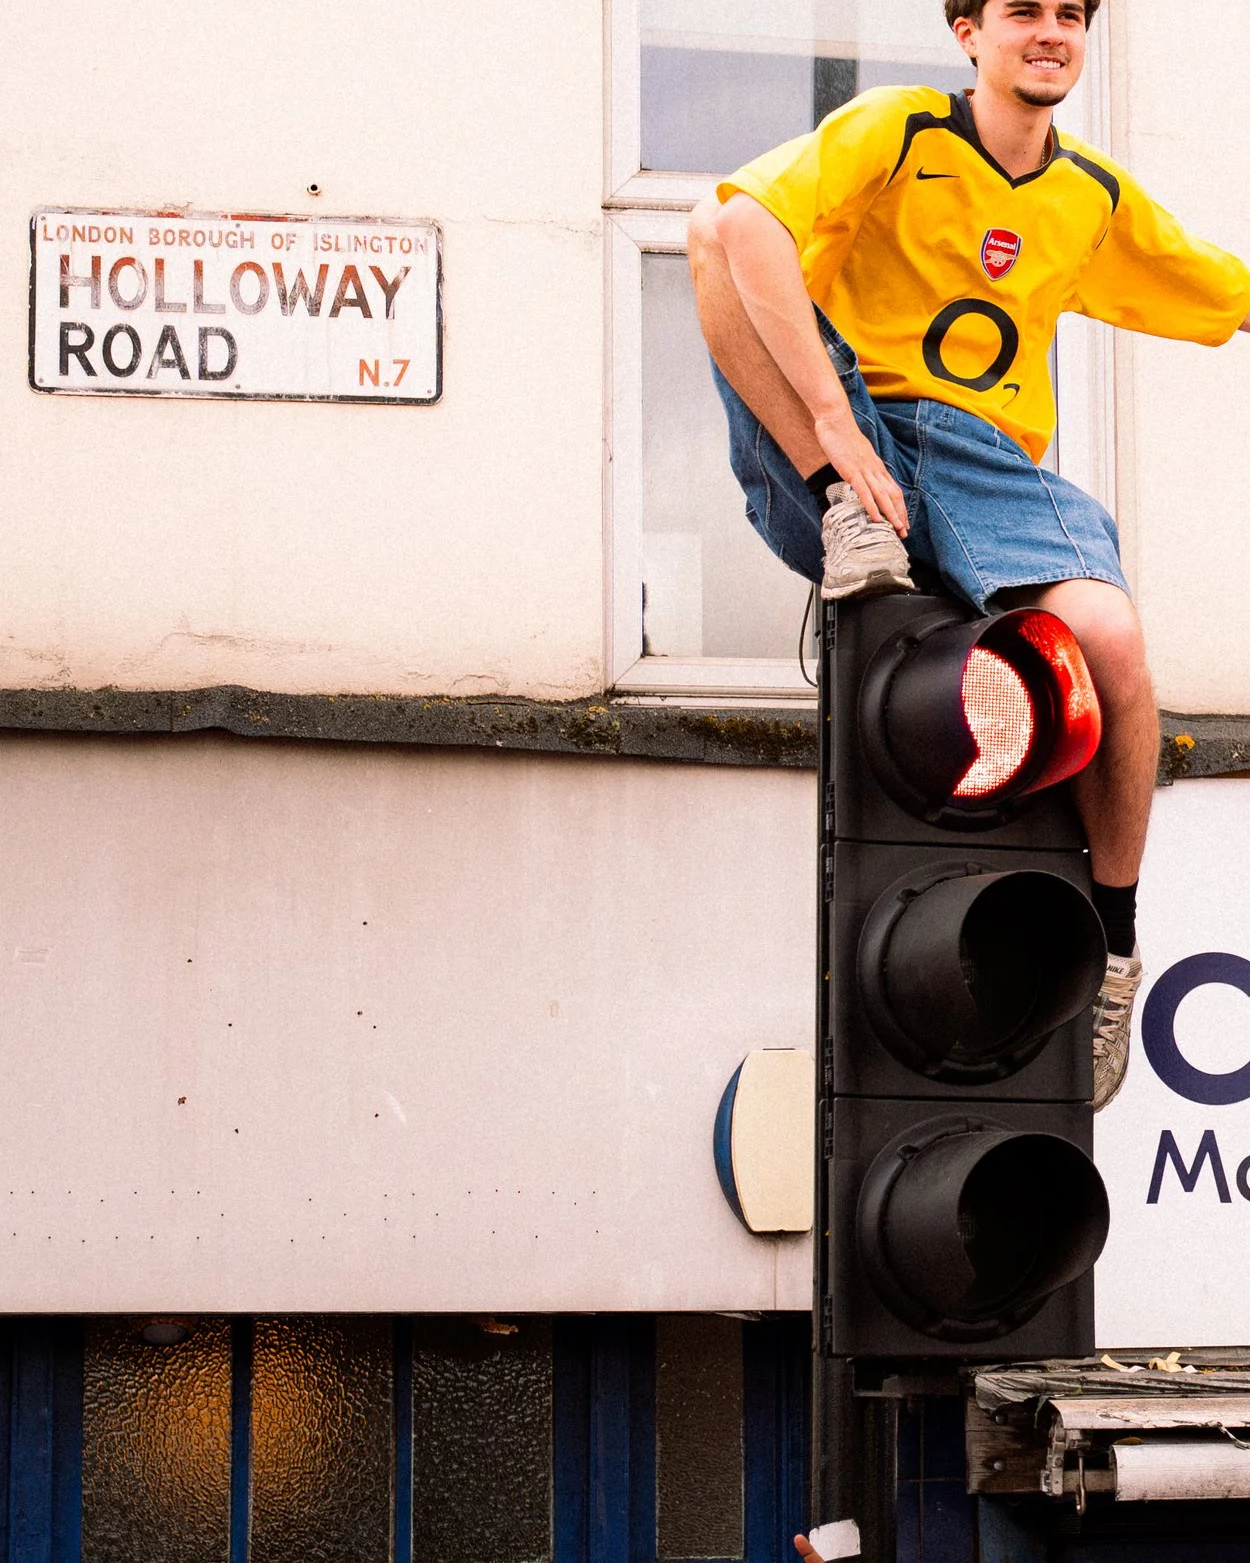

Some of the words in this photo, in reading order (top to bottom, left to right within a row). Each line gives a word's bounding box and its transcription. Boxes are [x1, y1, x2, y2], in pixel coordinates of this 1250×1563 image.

[42, 224, 134, 244] LONDON
[148, 228, 255, 249] BOROUGH
[271, 233, 297, 251] OF
[313, 233, 429, 255] ISLINGTON
[988, 237, 1017, 251] Arsenal
[59, 254, 412, 320] HOLLOWAY
[59, 321, 238, 381] ROAD
[359, 358, 411, 387] N.7
